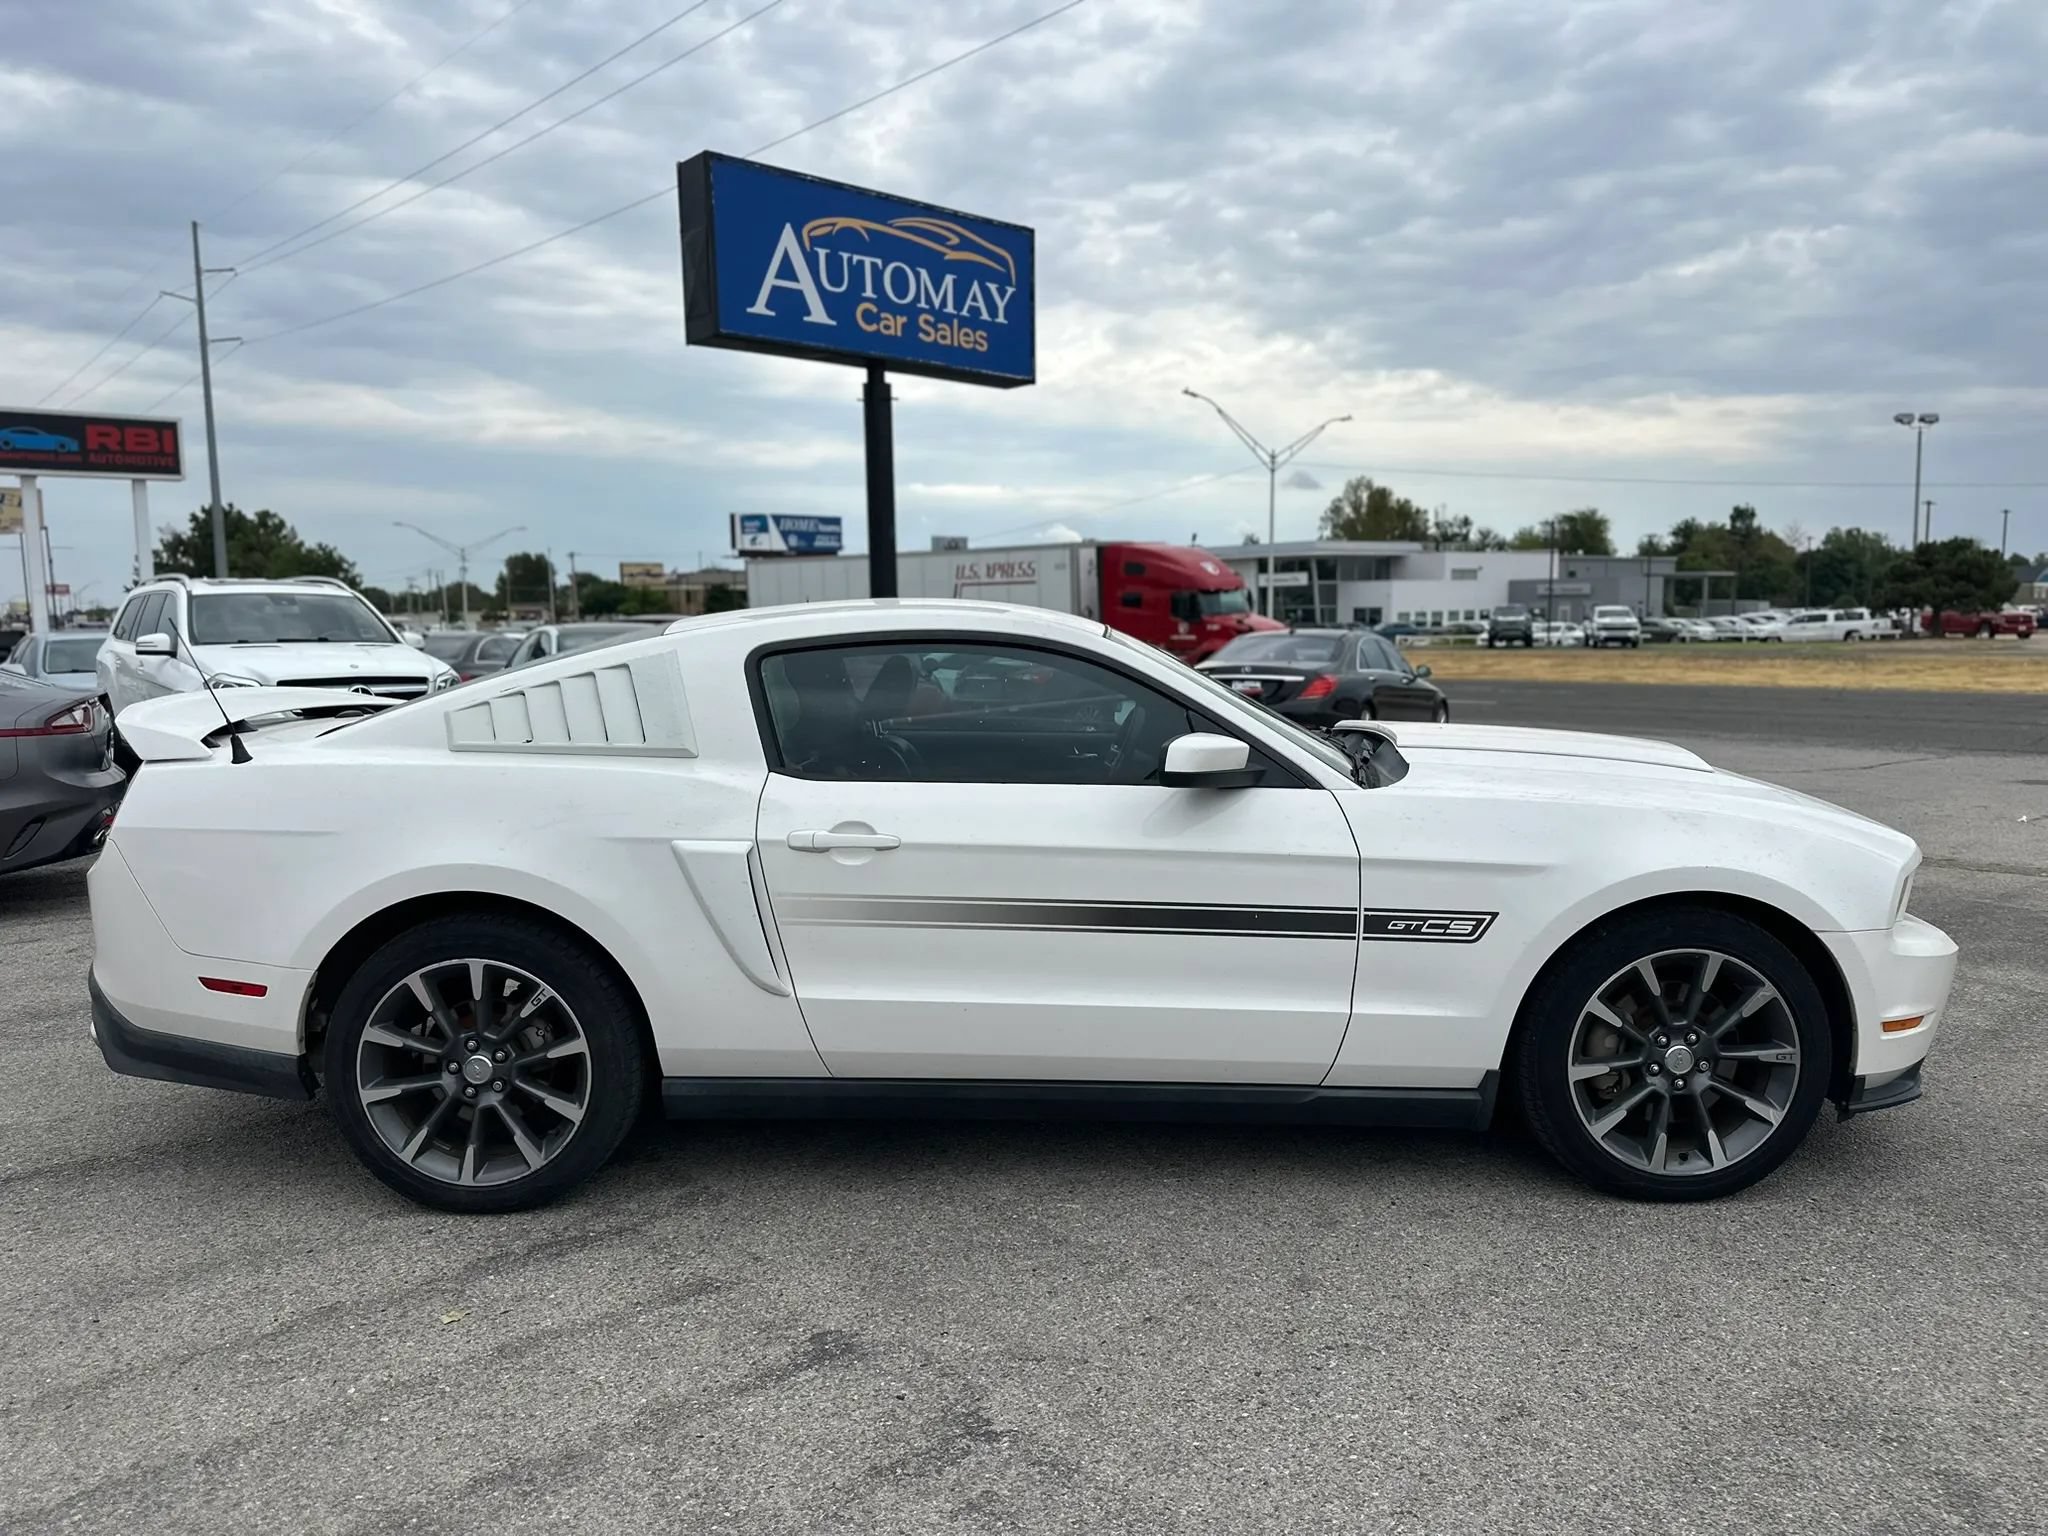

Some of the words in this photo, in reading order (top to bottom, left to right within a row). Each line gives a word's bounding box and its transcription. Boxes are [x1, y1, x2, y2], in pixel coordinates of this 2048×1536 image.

[746, 222, 1016, 327] AUTOMAY
[855, 302, 908, 338] Car
[918, 312, 988, 352] Sales
[86, 424, 175, 454] RBI
[88, 452, 177, 467] AUTOMOTIVE
[530, 987, 547, 1007] GT
[1775, 1052, 1797, 1061] GT
